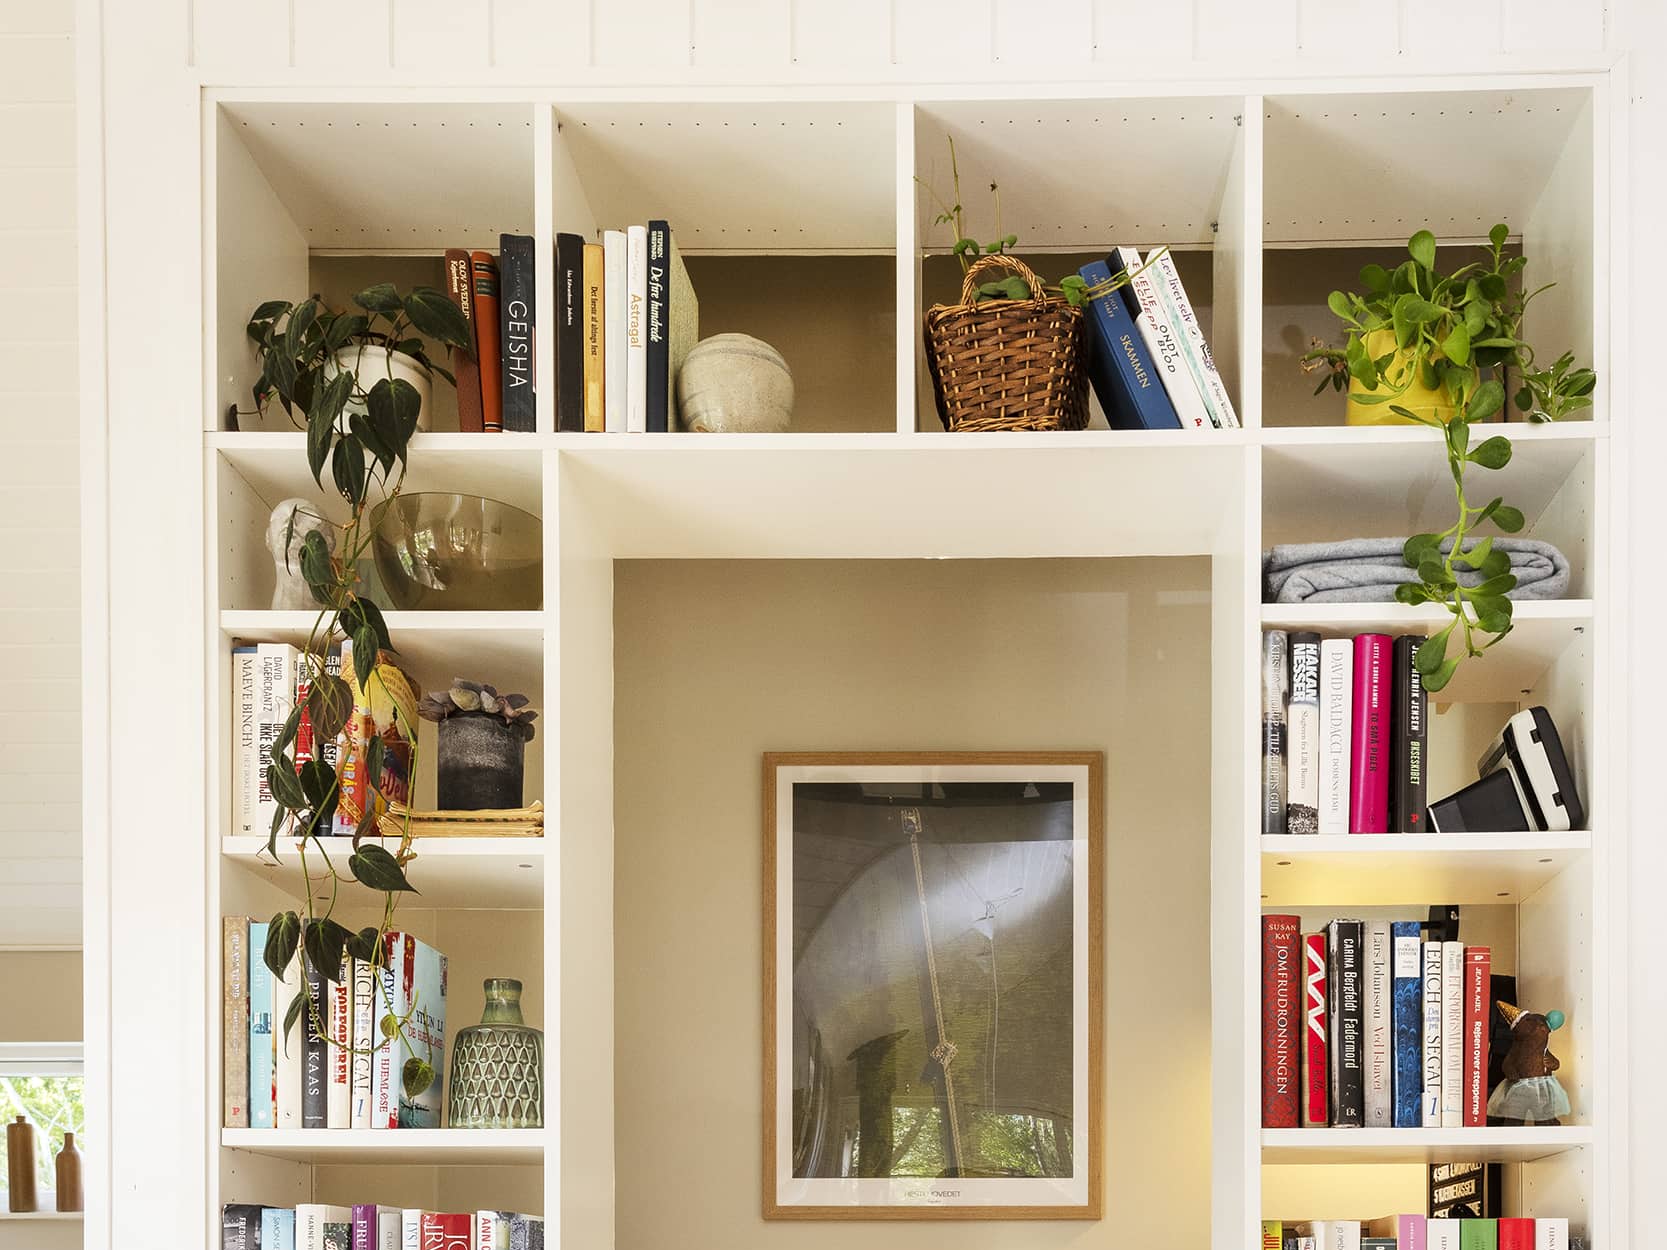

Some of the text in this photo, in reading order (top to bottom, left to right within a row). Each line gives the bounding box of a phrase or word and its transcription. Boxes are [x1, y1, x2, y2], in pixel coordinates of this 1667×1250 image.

[459, 260, 468, 282] OLOV
[629, 294, 642, 348] Astragal
[650, 267, 663, 343] De fire hundrede
[1134, 281, 1158, 330] SCHEPP
[1169, 279, 1192, 323] livet selv
[509, 301, 528, 388] GEISHA
[1120, 335, 1151, 388] SKAMMEN
[1158, 340, 1176, 373] BLOD
[1160, 325, 1179, 358] ONDT
[263, 657, 273, 712] LAGERCRANTZ
[274, 657, 283, 680] DAVID
[1293, 643, 1306, 702] NESSER
[1306, 644, 1319, 701] HÅKAN
[241, 659, 253, 749] MAEVE BINCHY
[1330, 652, 1344, 753] DAVID BALDACCI
[1411, 668, 1420, 731] HENRIK JENSEN
[260, 723, 272, 803] IKKE IHJEL
[1369, 748, 1378, 772] PIGER
[1410, 741, 1421, 786] ØKSESKIBET
[1271, 792, 1281, 814] GUD
[1373, 932, 1385, 1019] Lars Johansson
[1426, 949, 1441, 1003] ERICH
[1276, 945, 1289, 1094] JOMFRUDRONNINGEN
[1343, 939, 1359, 1069] CARINA Bergfeldt Fadermord
[308, 982, 320, 1095] PREBEN KAAS
[1374, 1026, 1385, 1091] Ved Ishavet
[1474, 1021, 1483, 1048] Rejsen
[354, 1037, 371, 1095] SEGAL
[379, 1058, 391, 1113] HJEMLØSE
[1426, 1036, 1441, 1093] SEGAL
[1472, 1070, 1482, 1115] stepperne
[237, 1217, 246, 1250] FREDERIK
[273, 1217, 281, 1241] SIMON
[406, 1222, 418, 1240] LYS
[481, 1217, 492, 1242] ANN
